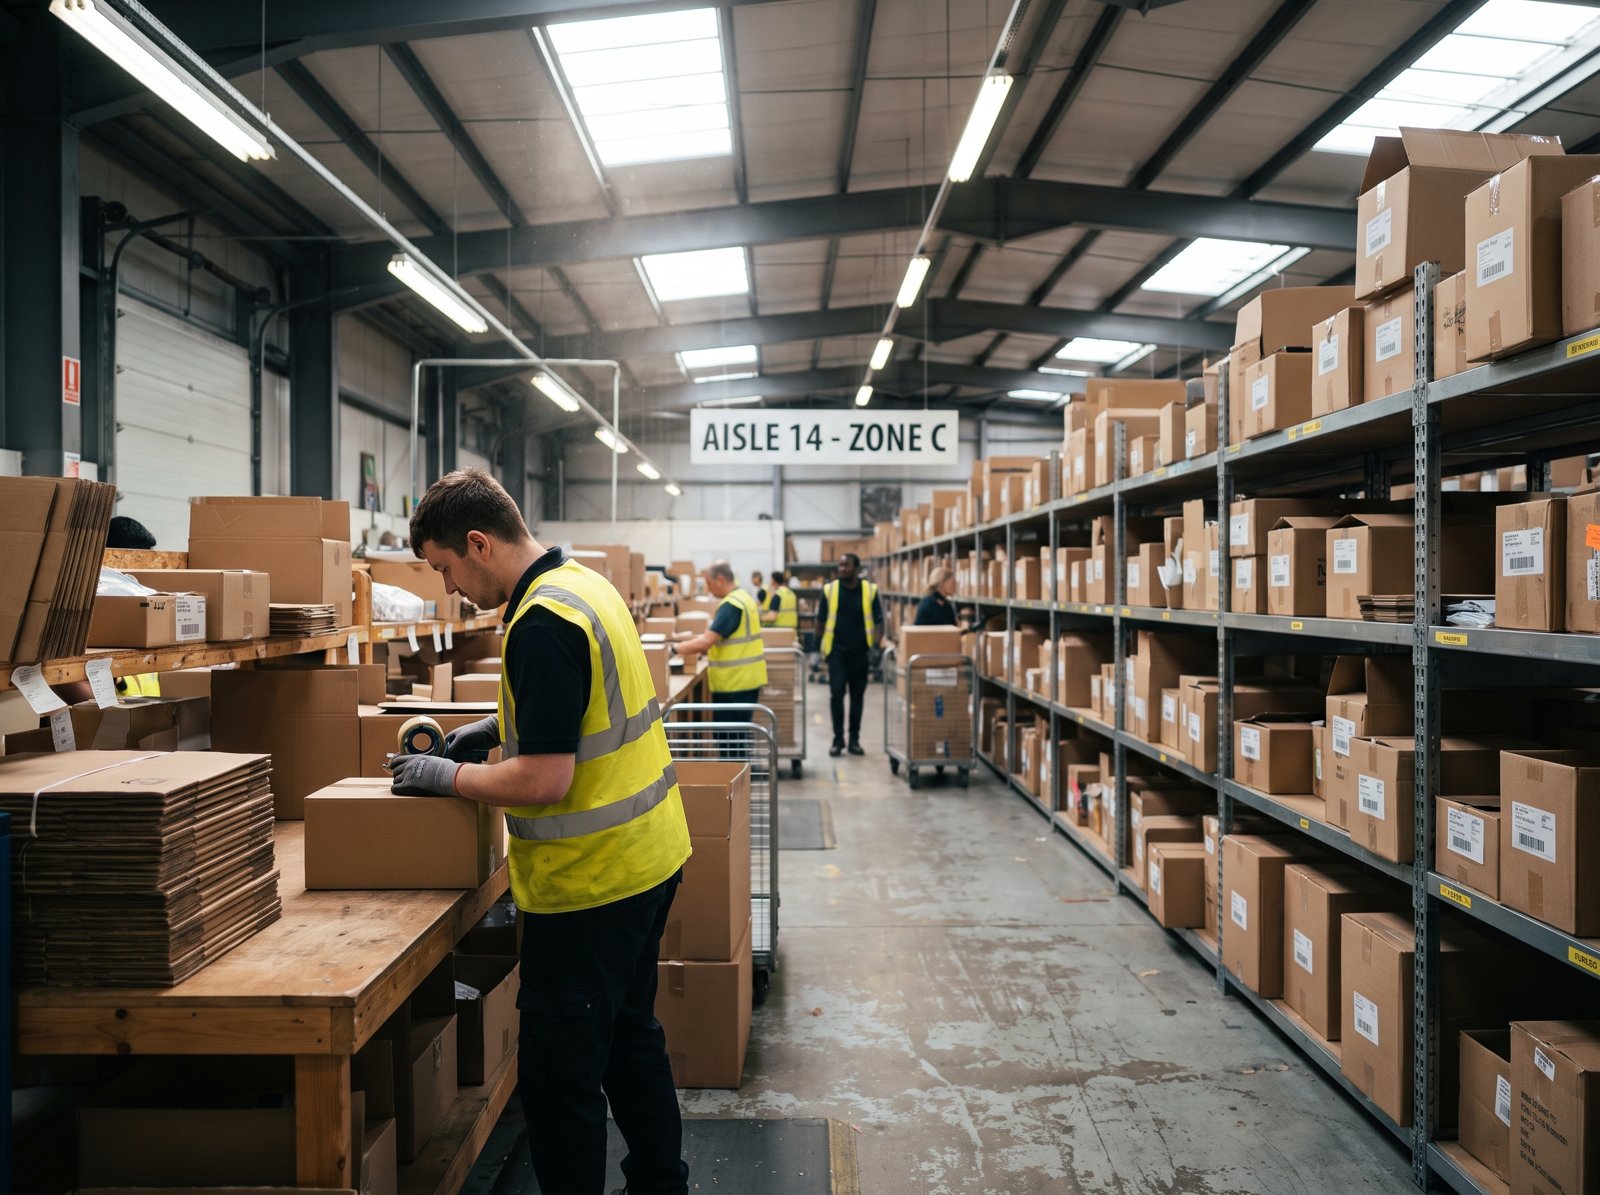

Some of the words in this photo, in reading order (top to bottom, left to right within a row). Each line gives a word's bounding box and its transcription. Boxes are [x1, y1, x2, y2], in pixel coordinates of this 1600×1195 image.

[702, 423, 780, 451] AISLE
[790, 423, 823, 451] 14
[849, 423, 922, 452] ZONE
[931, 423, 947, 452] C
